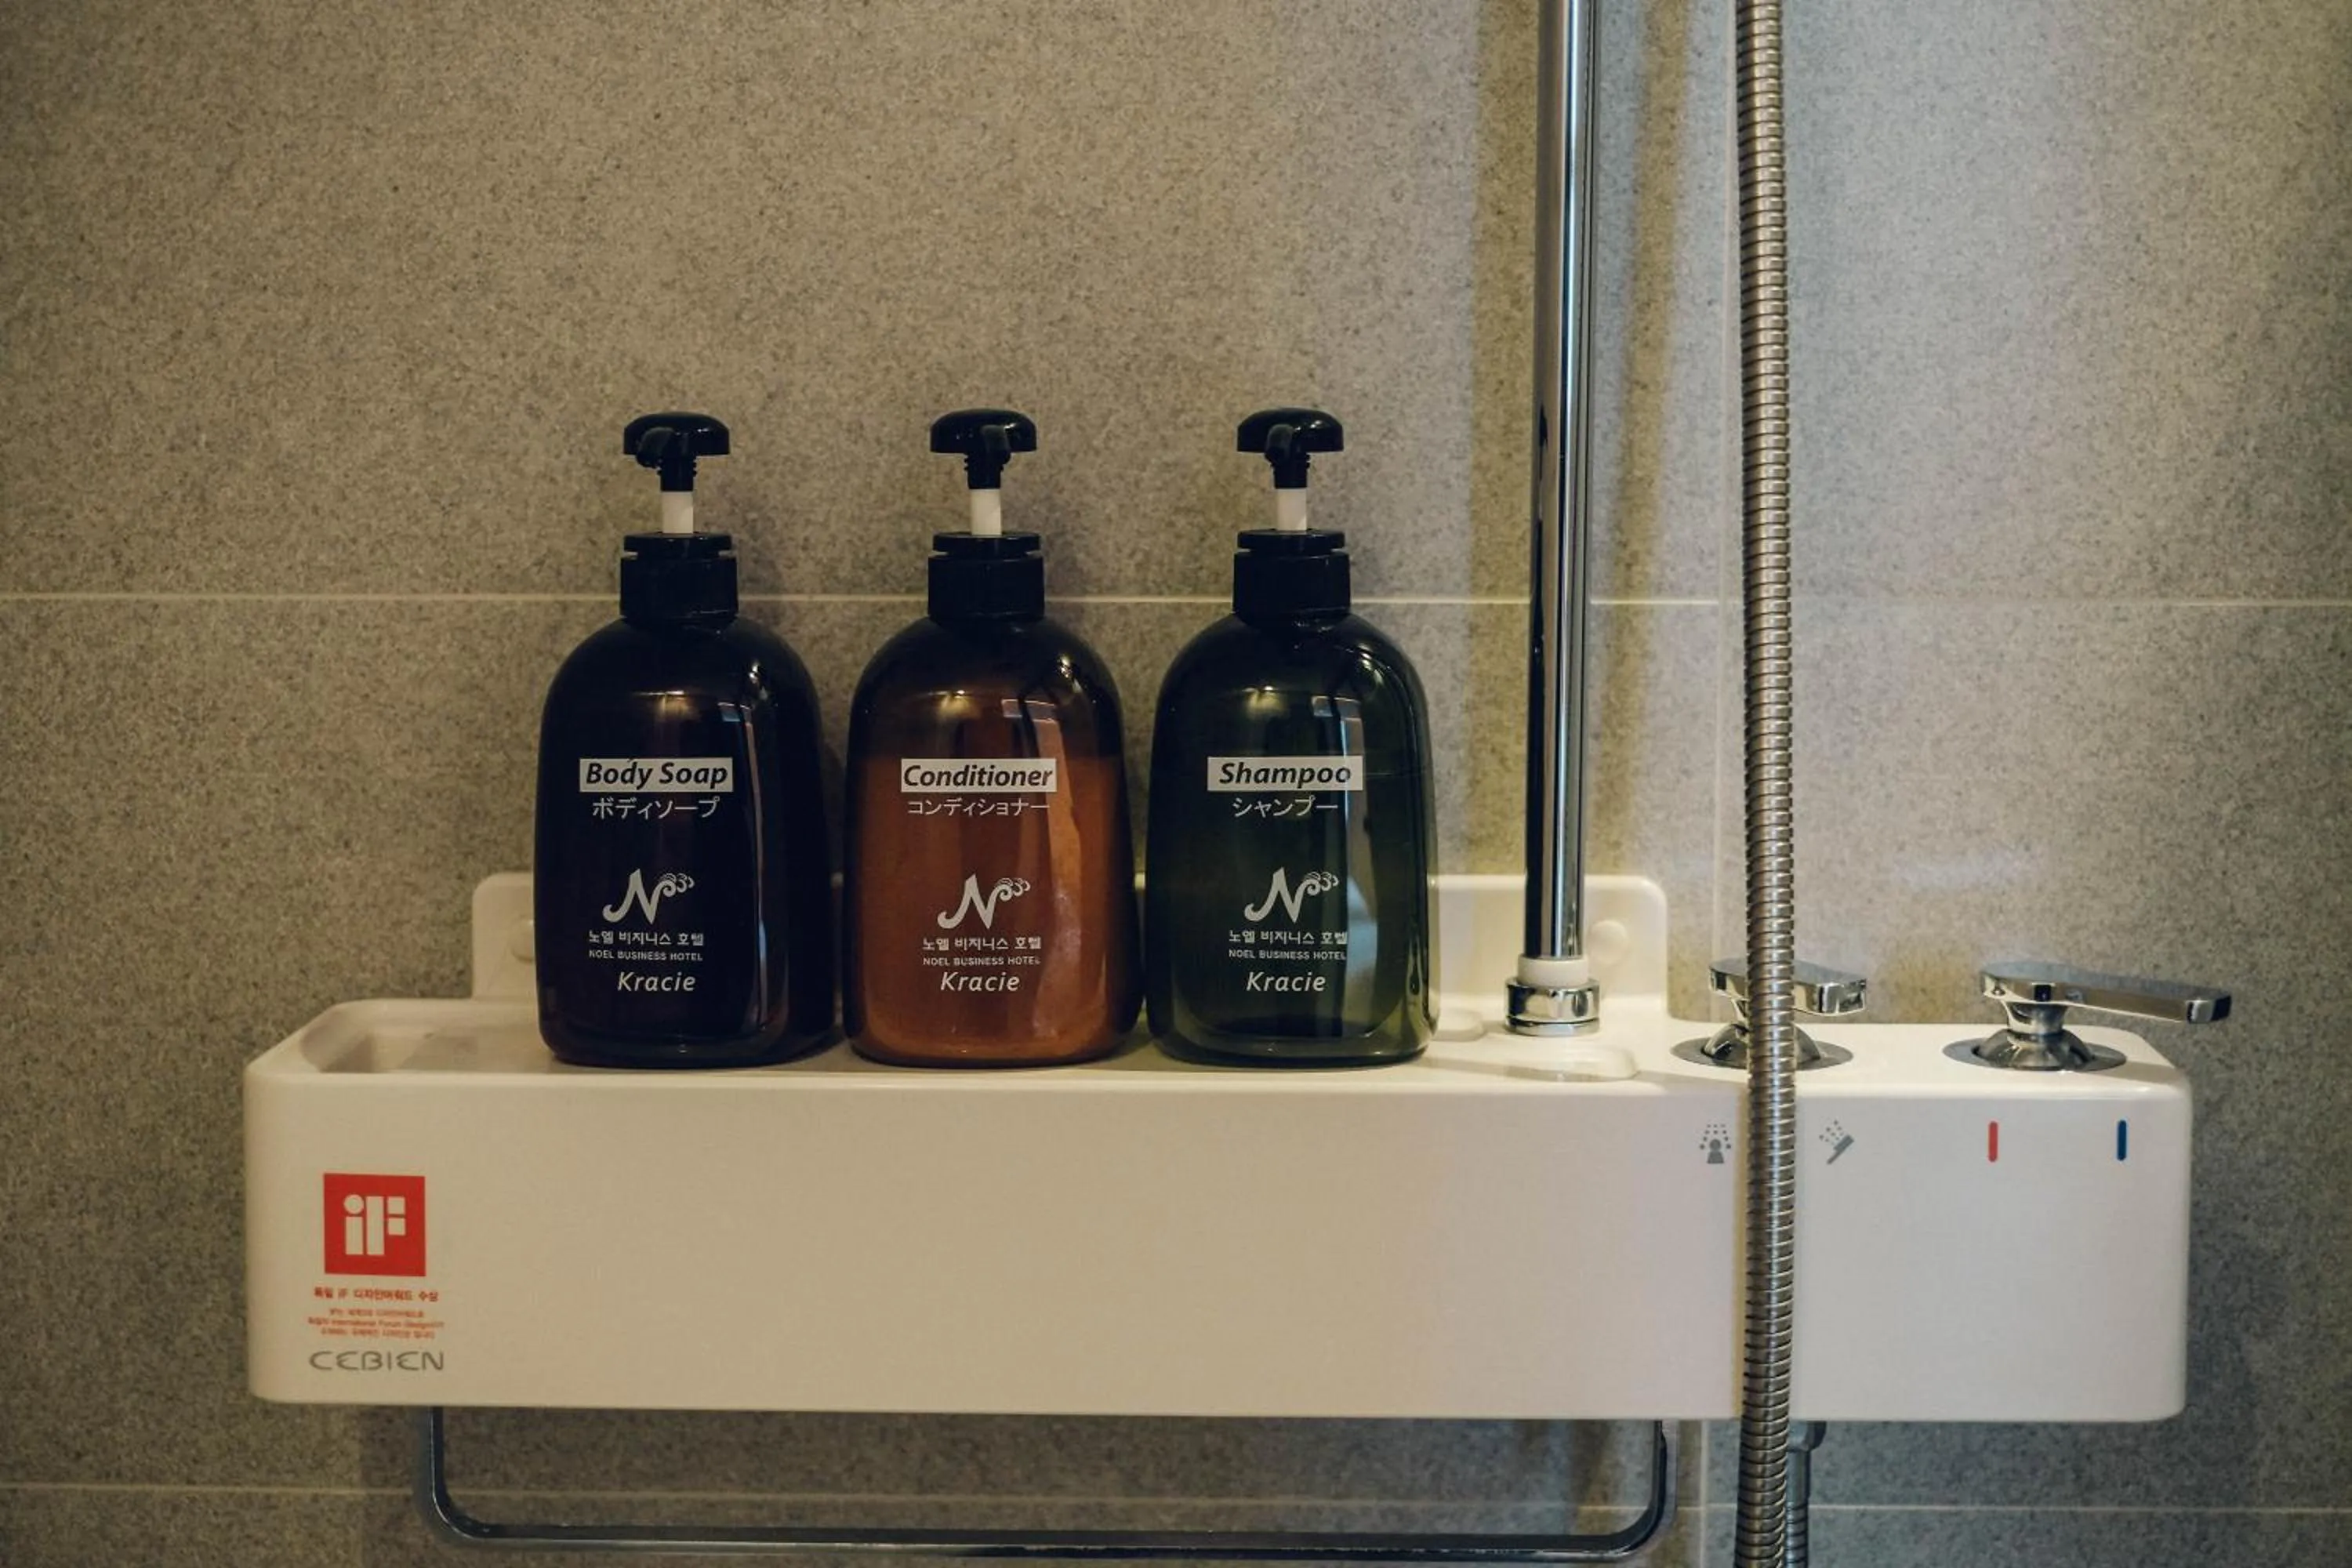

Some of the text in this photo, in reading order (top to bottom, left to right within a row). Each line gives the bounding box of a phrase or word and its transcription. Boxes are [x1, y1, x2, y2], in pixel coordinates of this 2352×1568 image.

[586, 759, 728, 790] Body Soap
[903, 764, 1053, 786] Conditioner
[1219, 762, 1352, 789] Shampoo
[592, 796, 720, 820] ボディソープ
[907, 798, 1051, 817] コンディショナー
[1232, 795, 1338, 818] シャンプー
[589, 949, 703, 961] NOEL BUSINESS HOTEL
[923, 956, 1041, 966] NOEL BUSINESS HOTEL
[1229, 949, 1347, 960] NOEL BUSINESS HOTEL
[617, 971, 696, 992] Kracie
[941, 971, 1020, 992] Kracie
[1246, 971, 1326, 992] Kracie
[309, 1350, 445, 1372] CEBIEN
